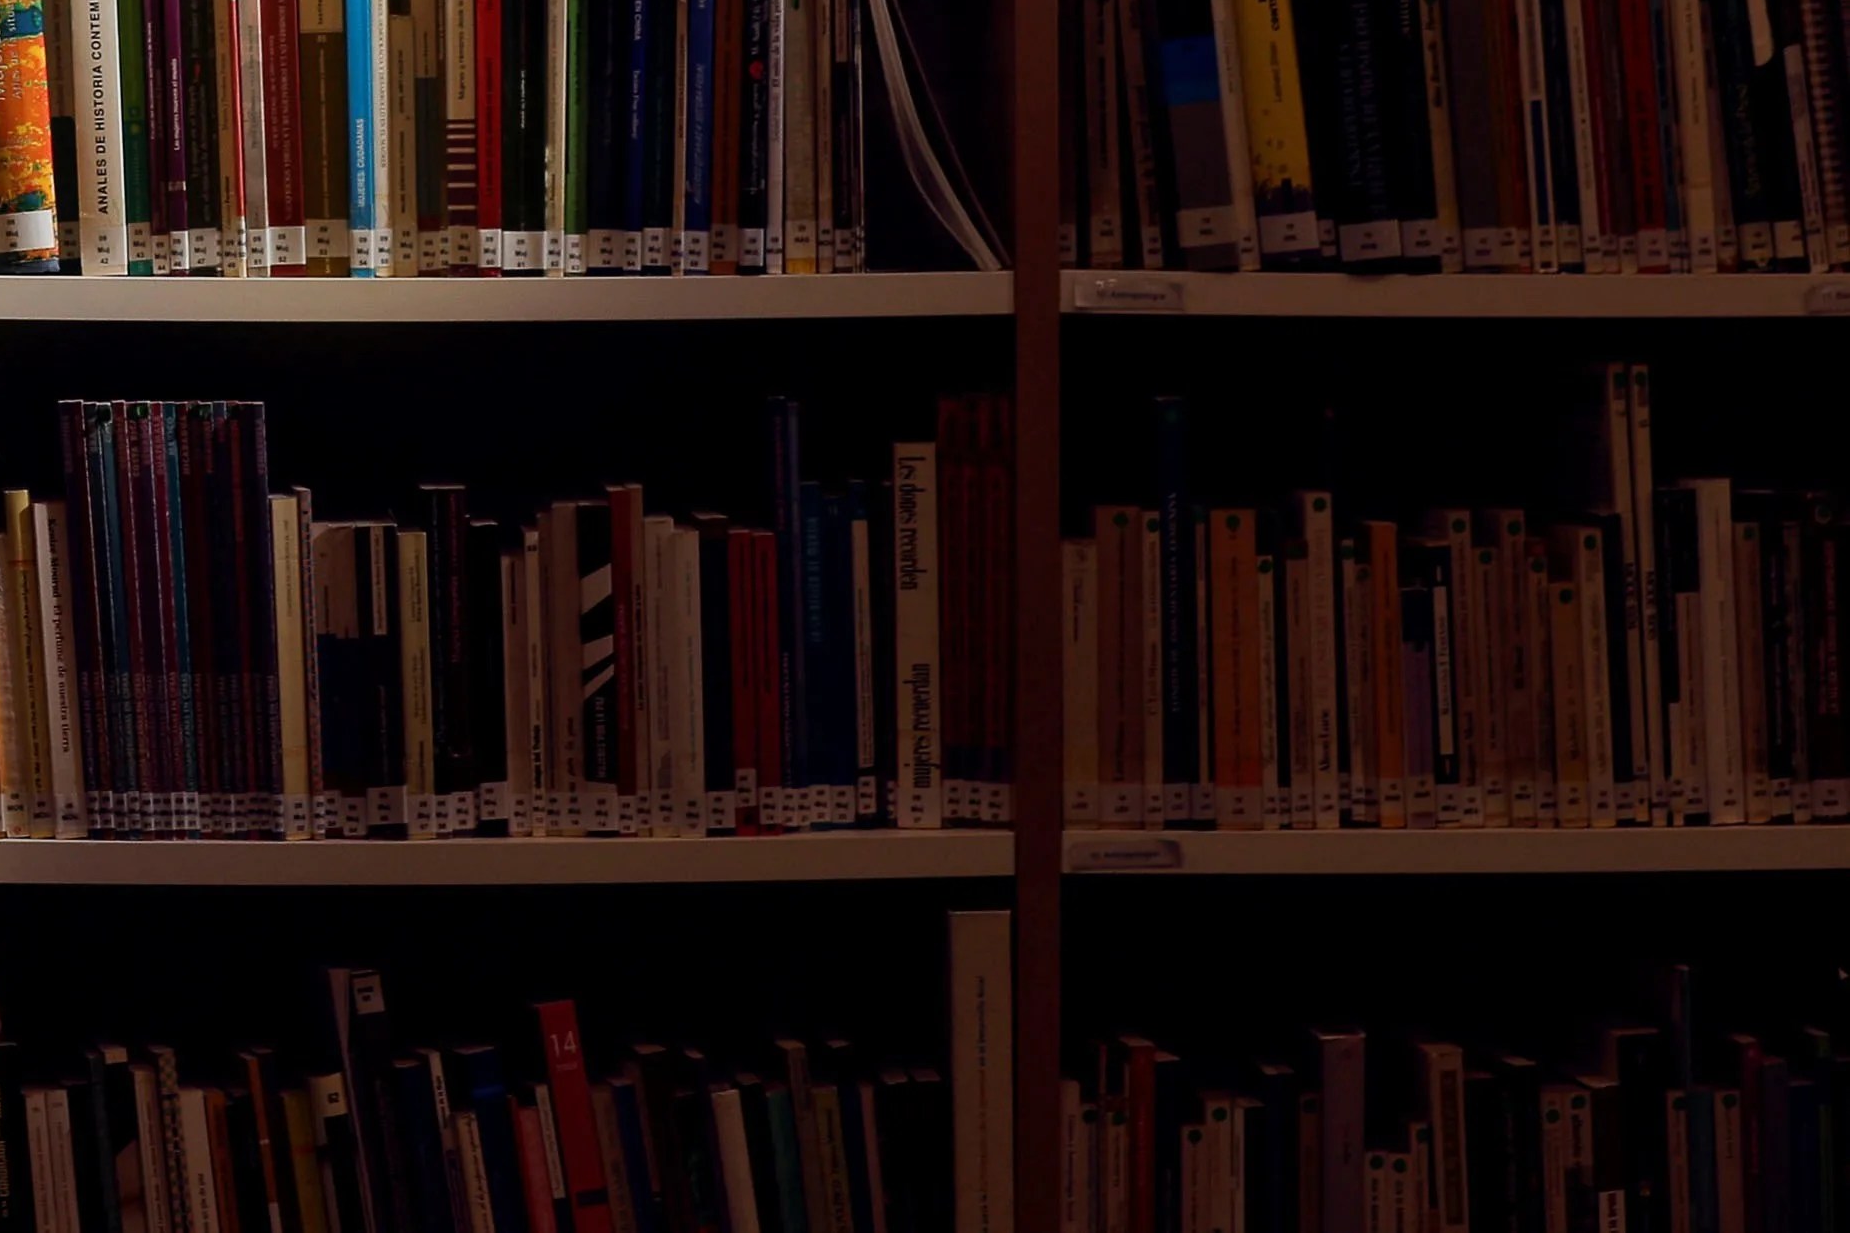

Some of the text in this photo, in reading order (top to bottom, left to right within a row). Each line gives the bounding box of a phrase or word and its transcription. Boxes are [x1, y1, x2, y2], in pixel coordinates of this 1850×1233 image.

[91, 64, 105, 131] HISTORIA
[95, 134, 106, 154] DE
[95, 158, 109, 214] ANALES
[899, 456, 928, 590] Les dones recorden
[57, 666, 68, 678] de
[902, 663, 939, 789] mujeres recuerdan
